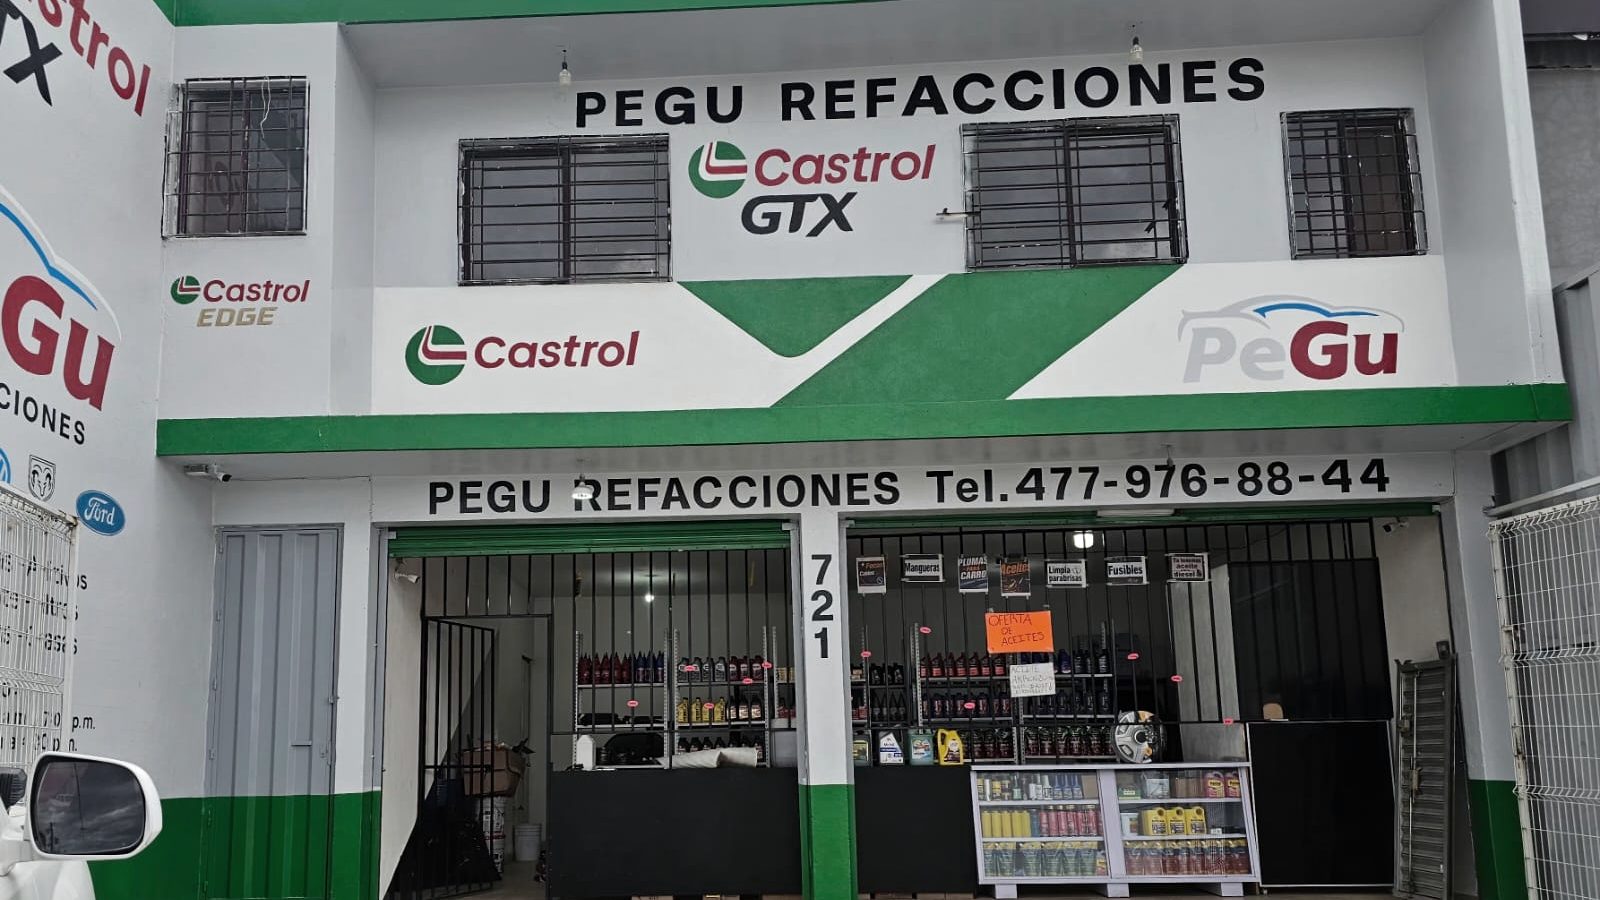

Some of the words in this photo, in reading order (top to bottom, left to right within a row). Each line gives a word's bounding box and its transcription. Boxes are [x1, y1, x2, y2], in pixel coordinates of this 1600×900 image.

[576, 85, 743, 128] PEGU
[781, 57, 1265, 121] REFACCIONES
[754, 144, 935, 187] Castrol
[741, 192, 857, 238] GTX
[203, 279, 310, 303] Castrol
[197, 307, 278, 327] EDGE
[474, 330, 640, 369] Castrol
[1183, 320, 1398, 383] PeGu
[429, 479, 551, 514] PEGU
[574, 470, 901, 512] REFACCIONES
[84, 496, 116, 526] Ford
[905, 562, 940, 574] Mangueras
[960, 570, 987, 580] CARRO
[1048, 565, 1071, 574] Limpia
[1108, 564, 1143, 576] Fusibles
[988, 613, 1033, 627] OFERTA
[1001, 632, 1046, 647] ACEITES
[71, 716, 96, 732] p.m.
